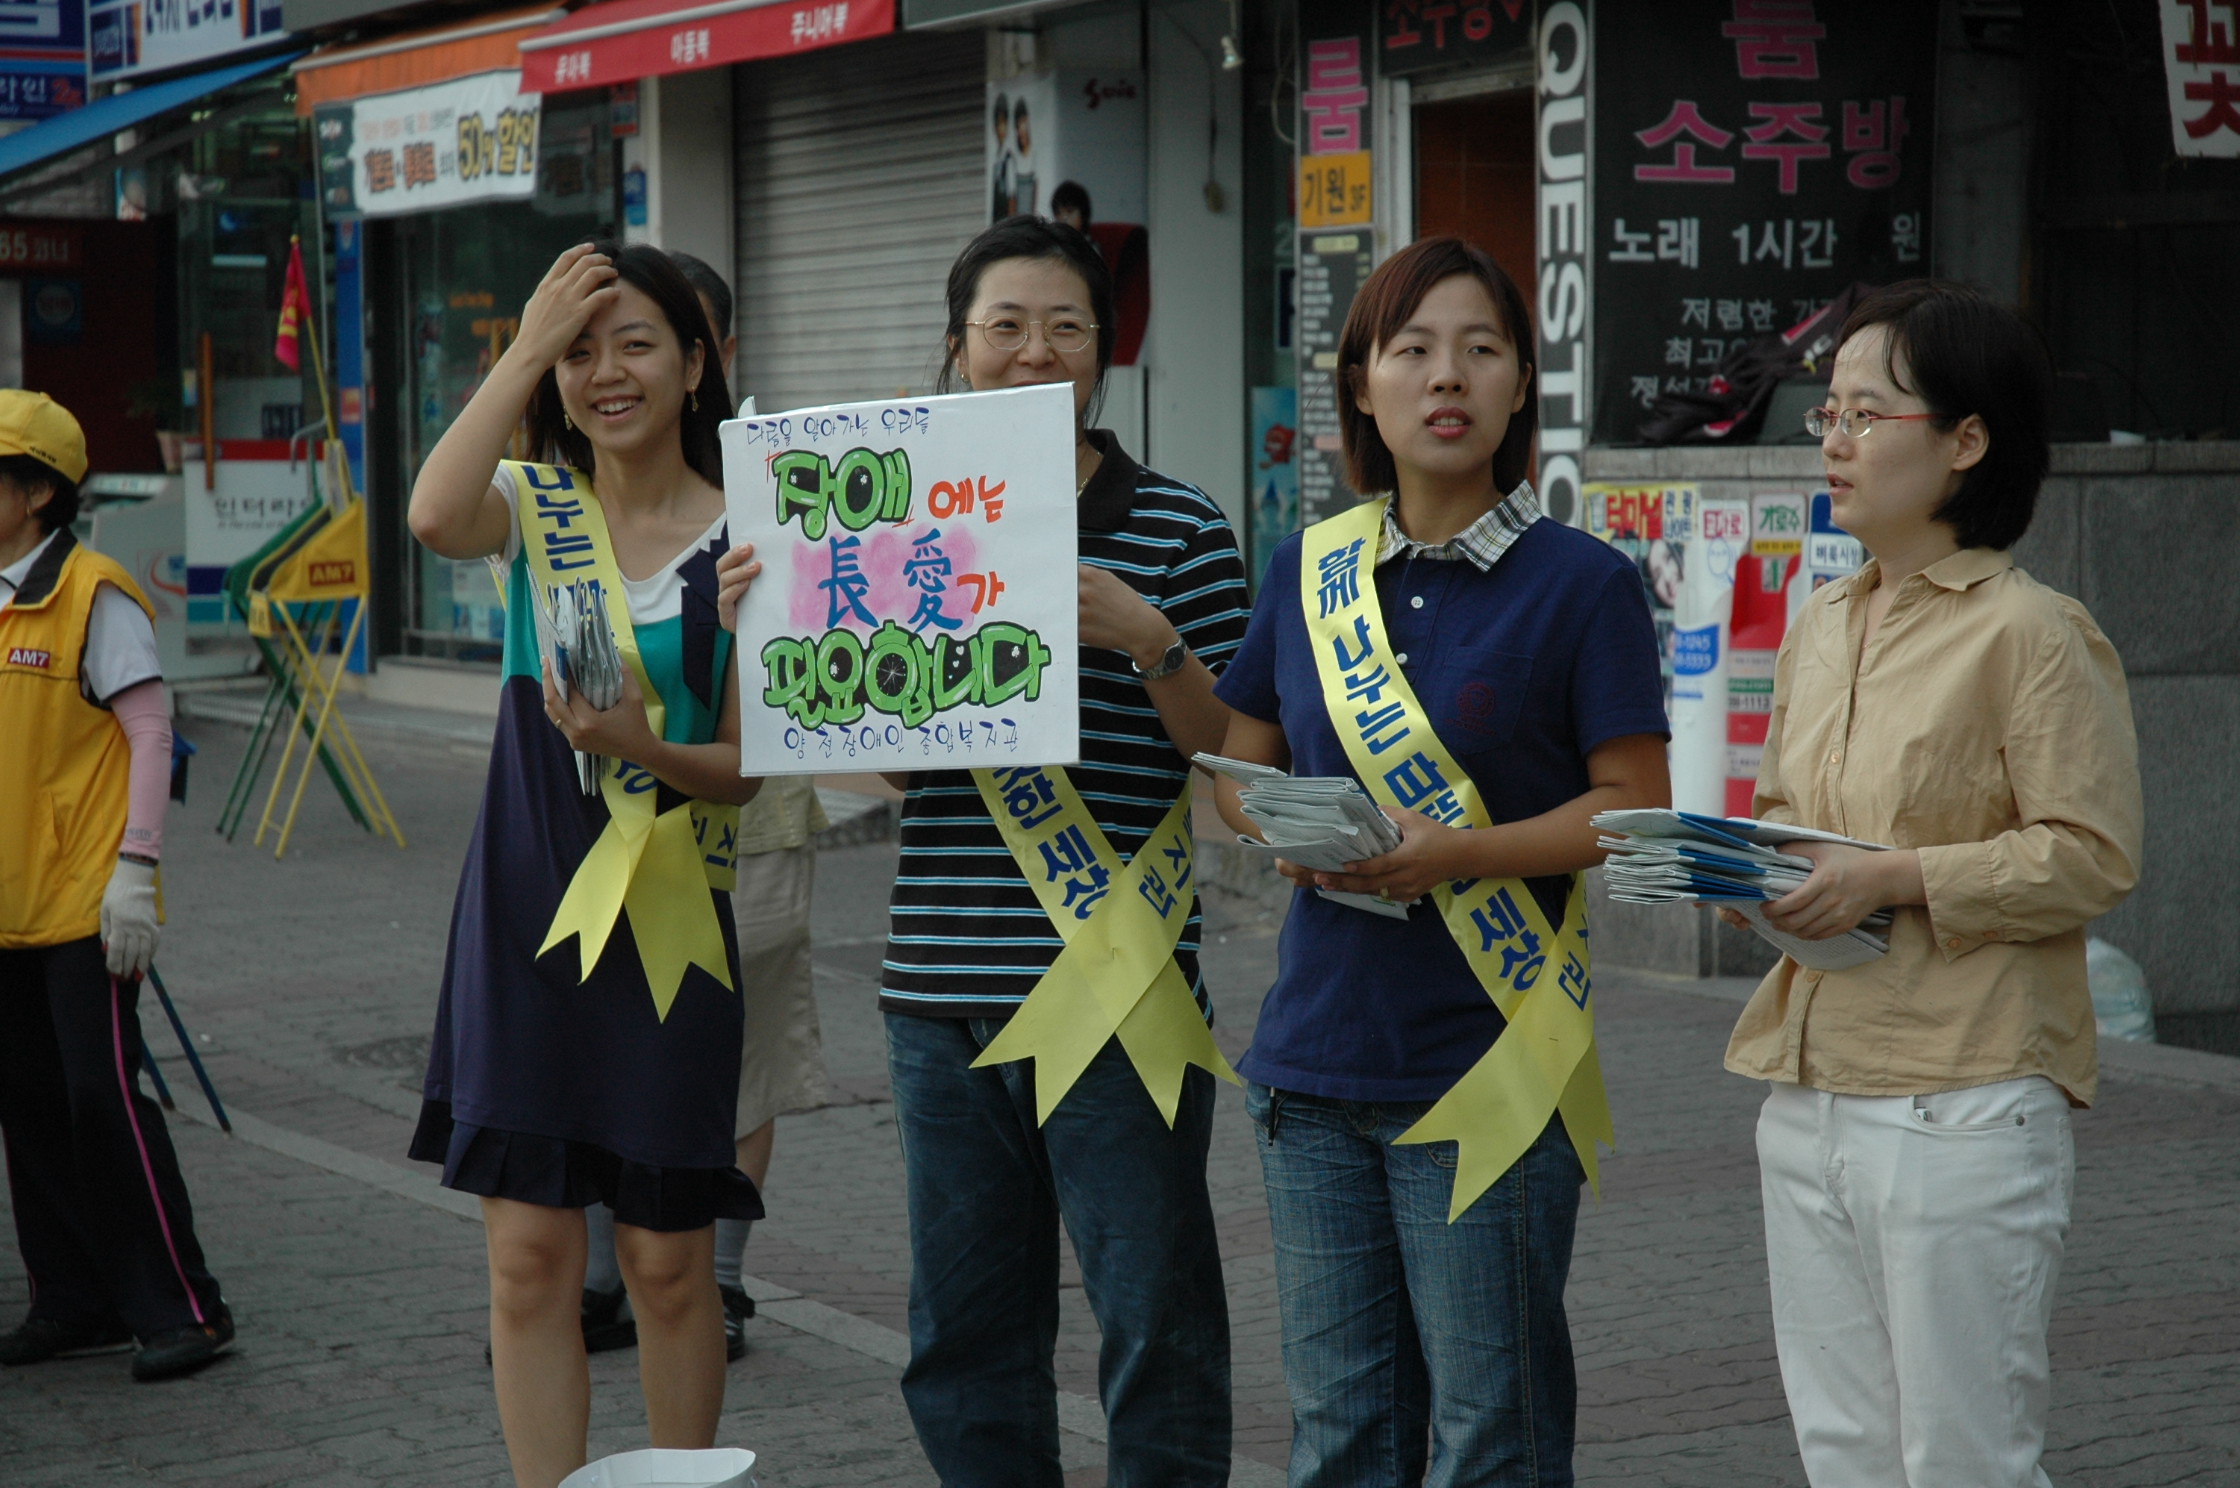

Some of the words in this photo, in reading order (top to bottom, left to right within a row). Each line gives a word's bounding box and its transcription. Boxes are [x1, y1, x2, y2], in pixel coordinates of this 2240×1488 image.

[1303, 36, 1368, 154] 룸
[1633, 96, 1910, 195] 소주방
[1608, 216, 1701, 270] 노래
[1732, 216, 1838, 270] 1시간
[1681, 297, 1776, 333] 저렴한
[746, 417, 793, 448] 다름을
[803, 413, 870, 443] 알아가는
[880, 406, 930, 437] 우리들
[521, 465, 597, 572] 나누는
[1316, 537, 1366, 620] 함께
[760, 619, 1052, 730] 필요합니다
[1332, 614, 1411, 756] 나누는
[1470, 886, 1548, 992] 세상
